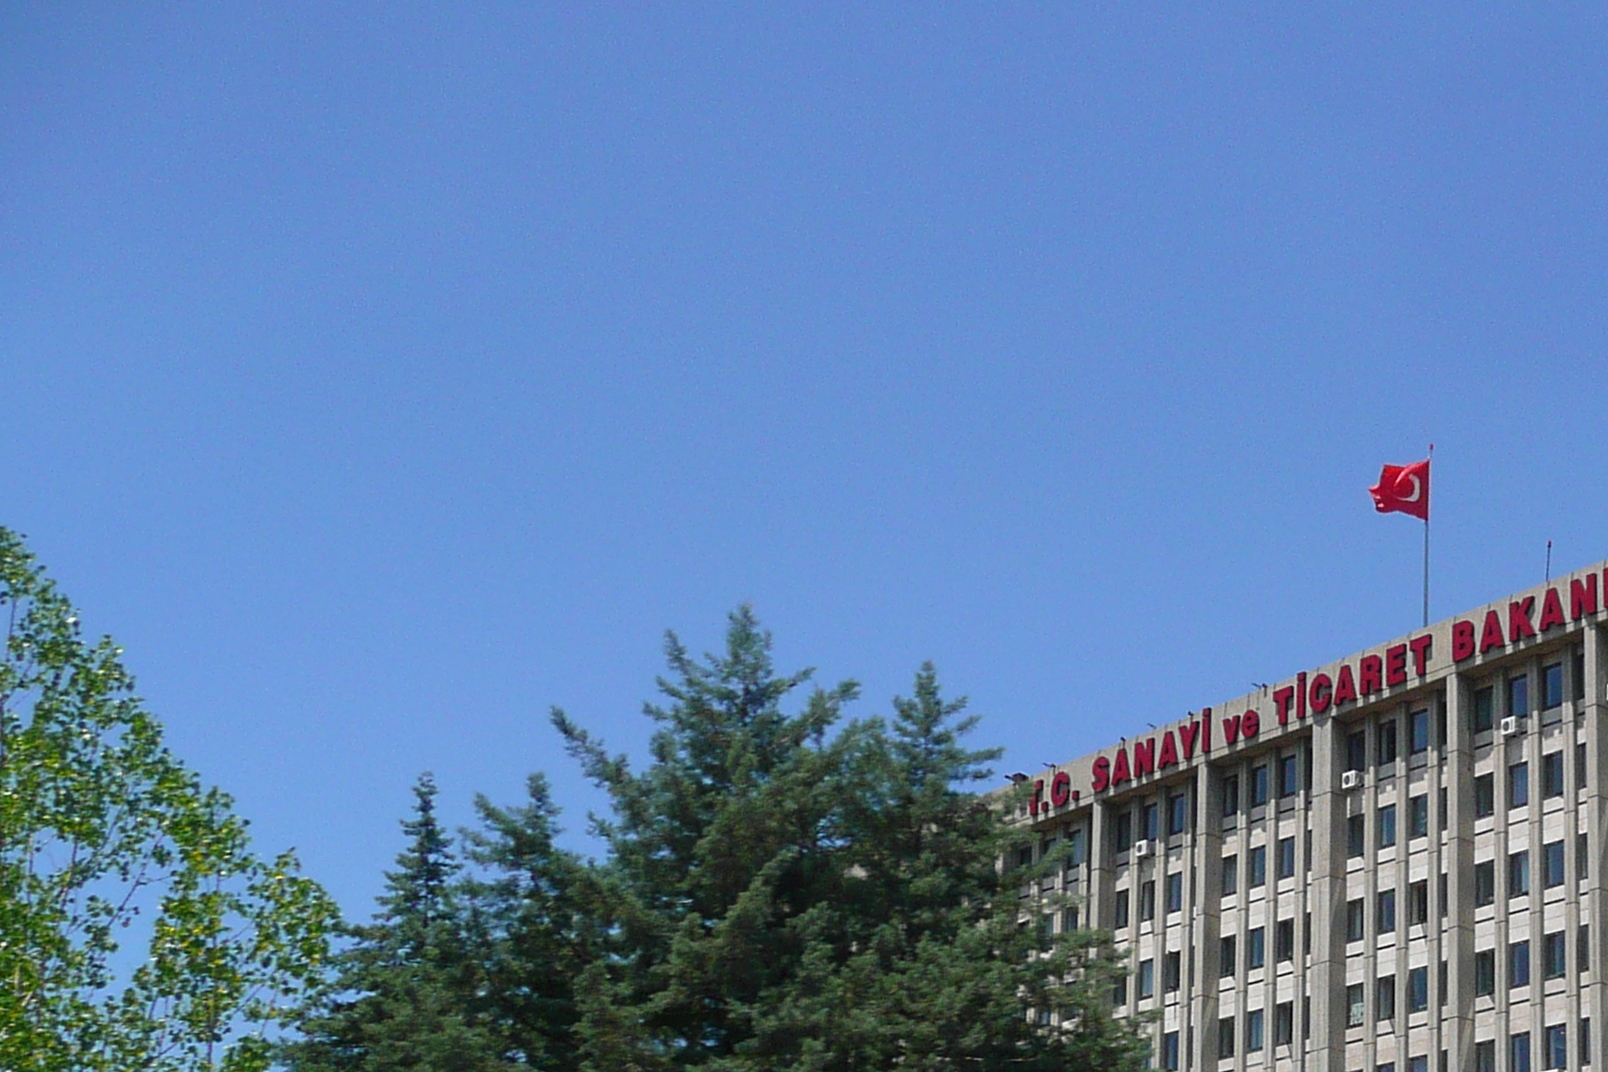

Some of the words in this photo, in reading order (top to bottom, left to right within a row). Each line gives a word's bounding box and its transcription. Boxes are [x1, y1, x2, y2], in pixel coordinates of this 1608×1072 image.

[1092, 708, 1212, 793] SANAYİ
[1222, 708, 1260, 744] ve
[1273, 633, 1433, 726] TİCARET
